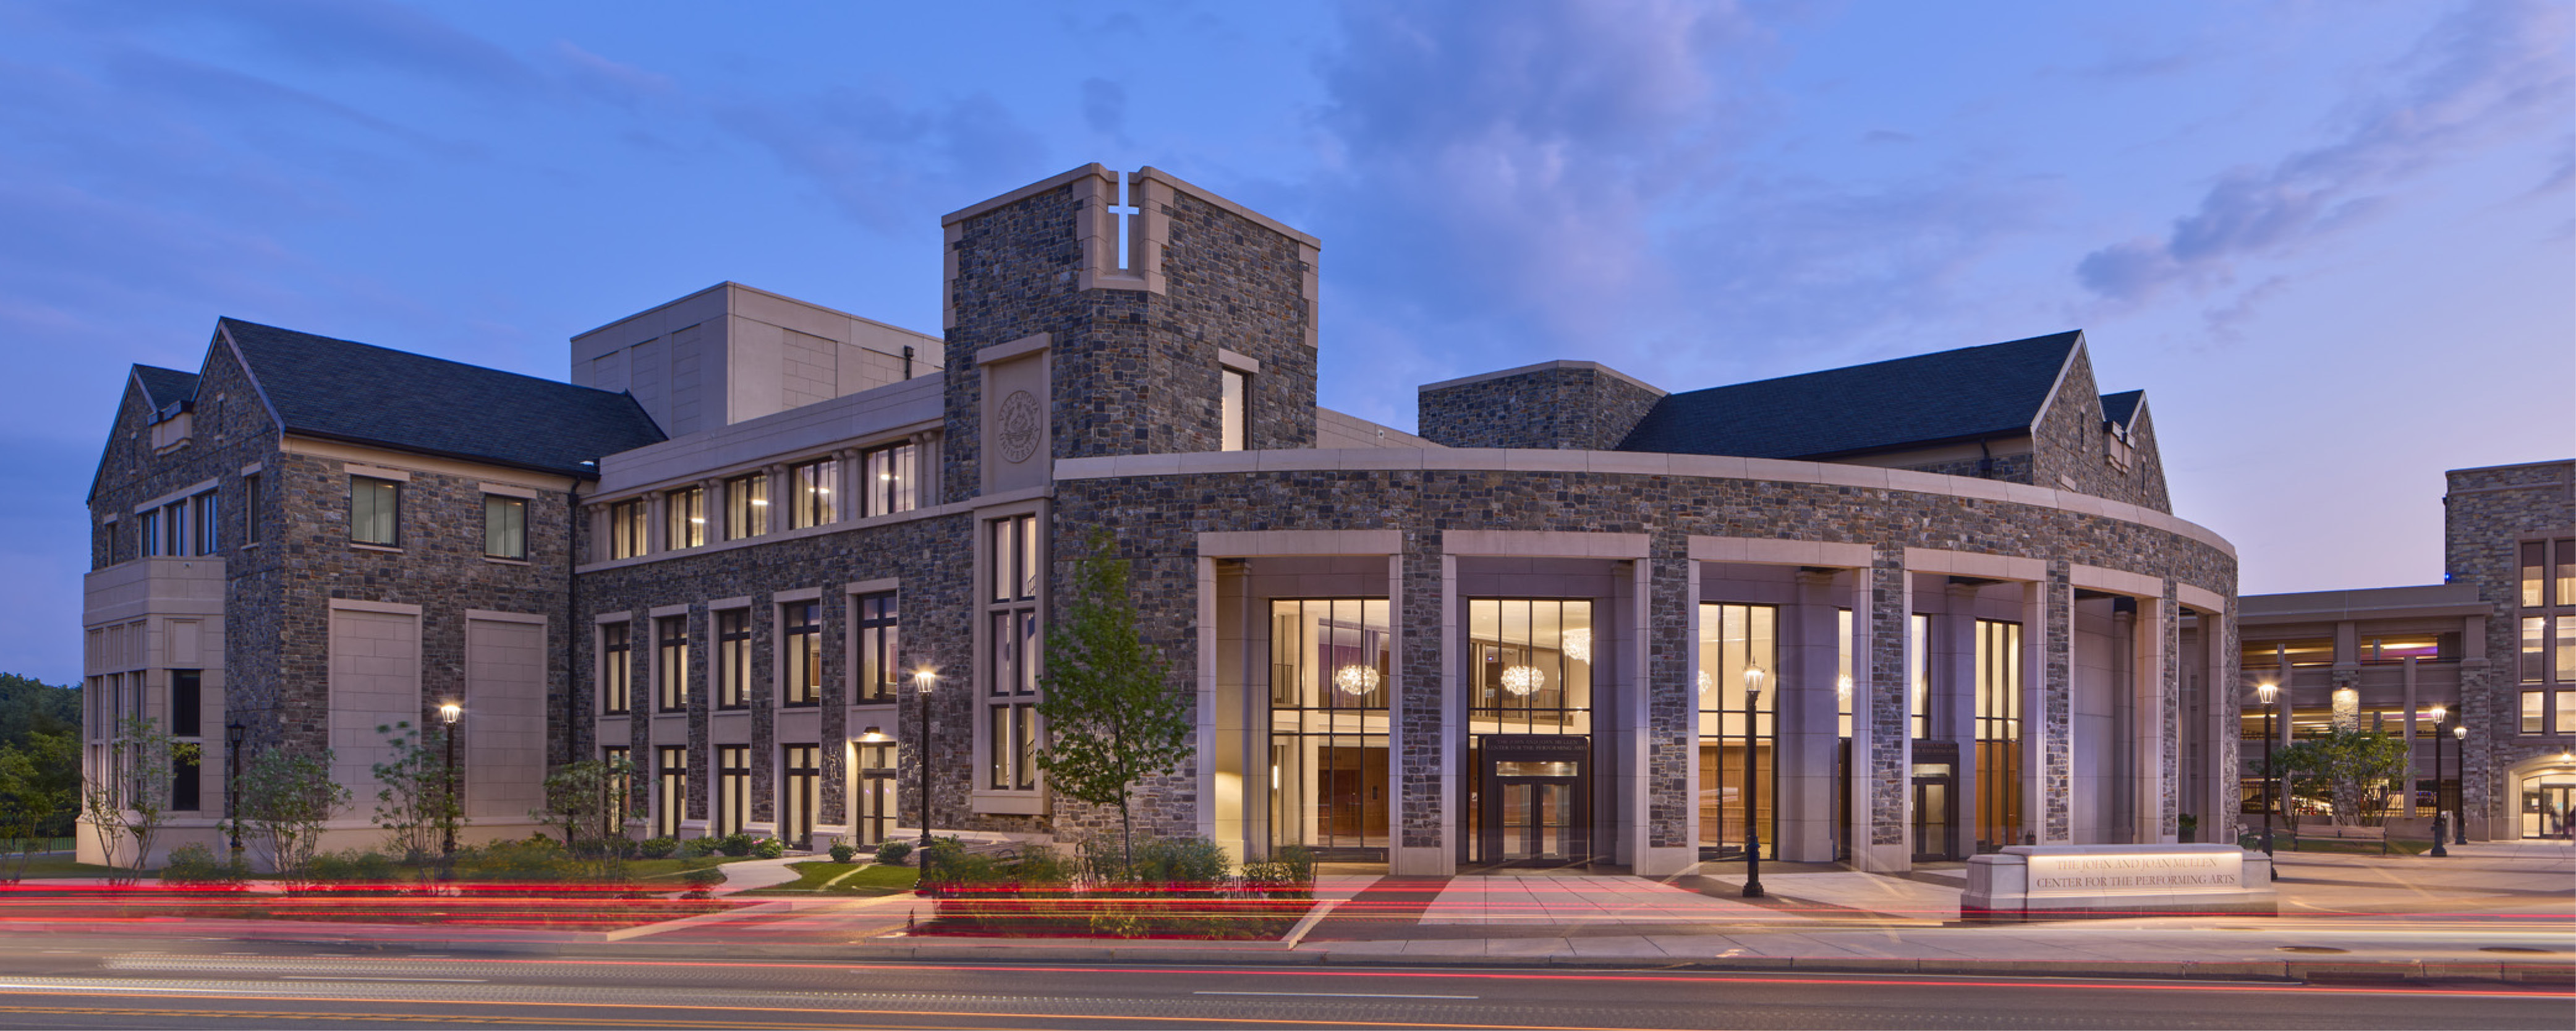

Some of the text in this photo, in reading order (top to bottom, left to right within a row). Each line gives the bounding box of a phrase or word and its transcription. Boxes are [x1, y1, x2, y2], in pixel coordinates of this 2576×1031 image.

[2057, 857, 2217, 873] THE JOHN AND JOAN MULLEN
[2036, 874, 2235, 888] CENTER FOR THE PERFORMING ARTS
